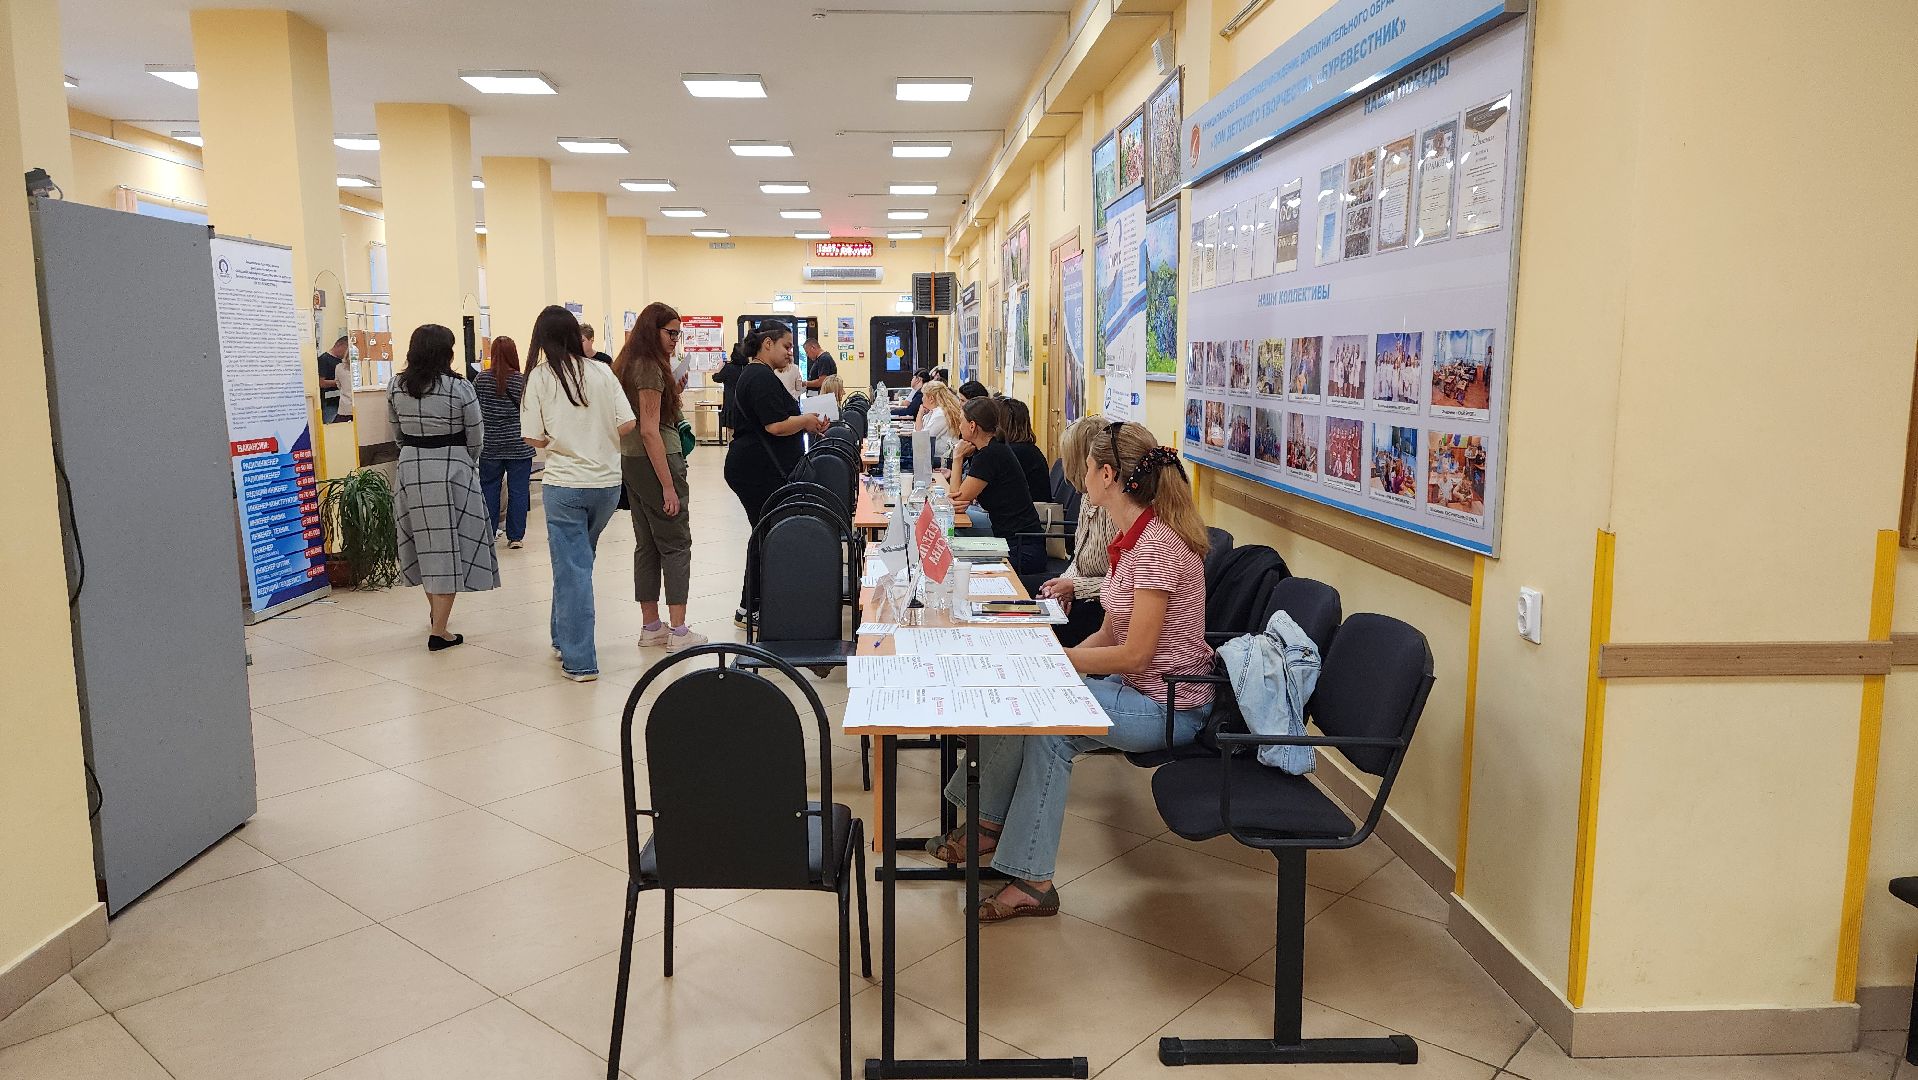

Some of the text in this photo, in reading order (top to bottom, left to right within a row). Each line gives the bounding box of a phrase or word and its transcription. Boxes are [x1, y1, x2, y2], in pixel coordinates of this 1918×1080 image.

[1300, 9, 1368, 65] ДОПОЛНИТЕЛЬНОГО
[1227, 110, 1260, 142] ДЕТСКОГО
[1316, 16, 1406, 85] «БУРЕВЕСТНИК»
[1364, 85, 1394, 116] НАШИ
[1258, 283, 1331, 307] НАШИ КОЛЛЕКТИВЫ
[244, 471, 281, 483] РАДИОИНЖЕНЕР
